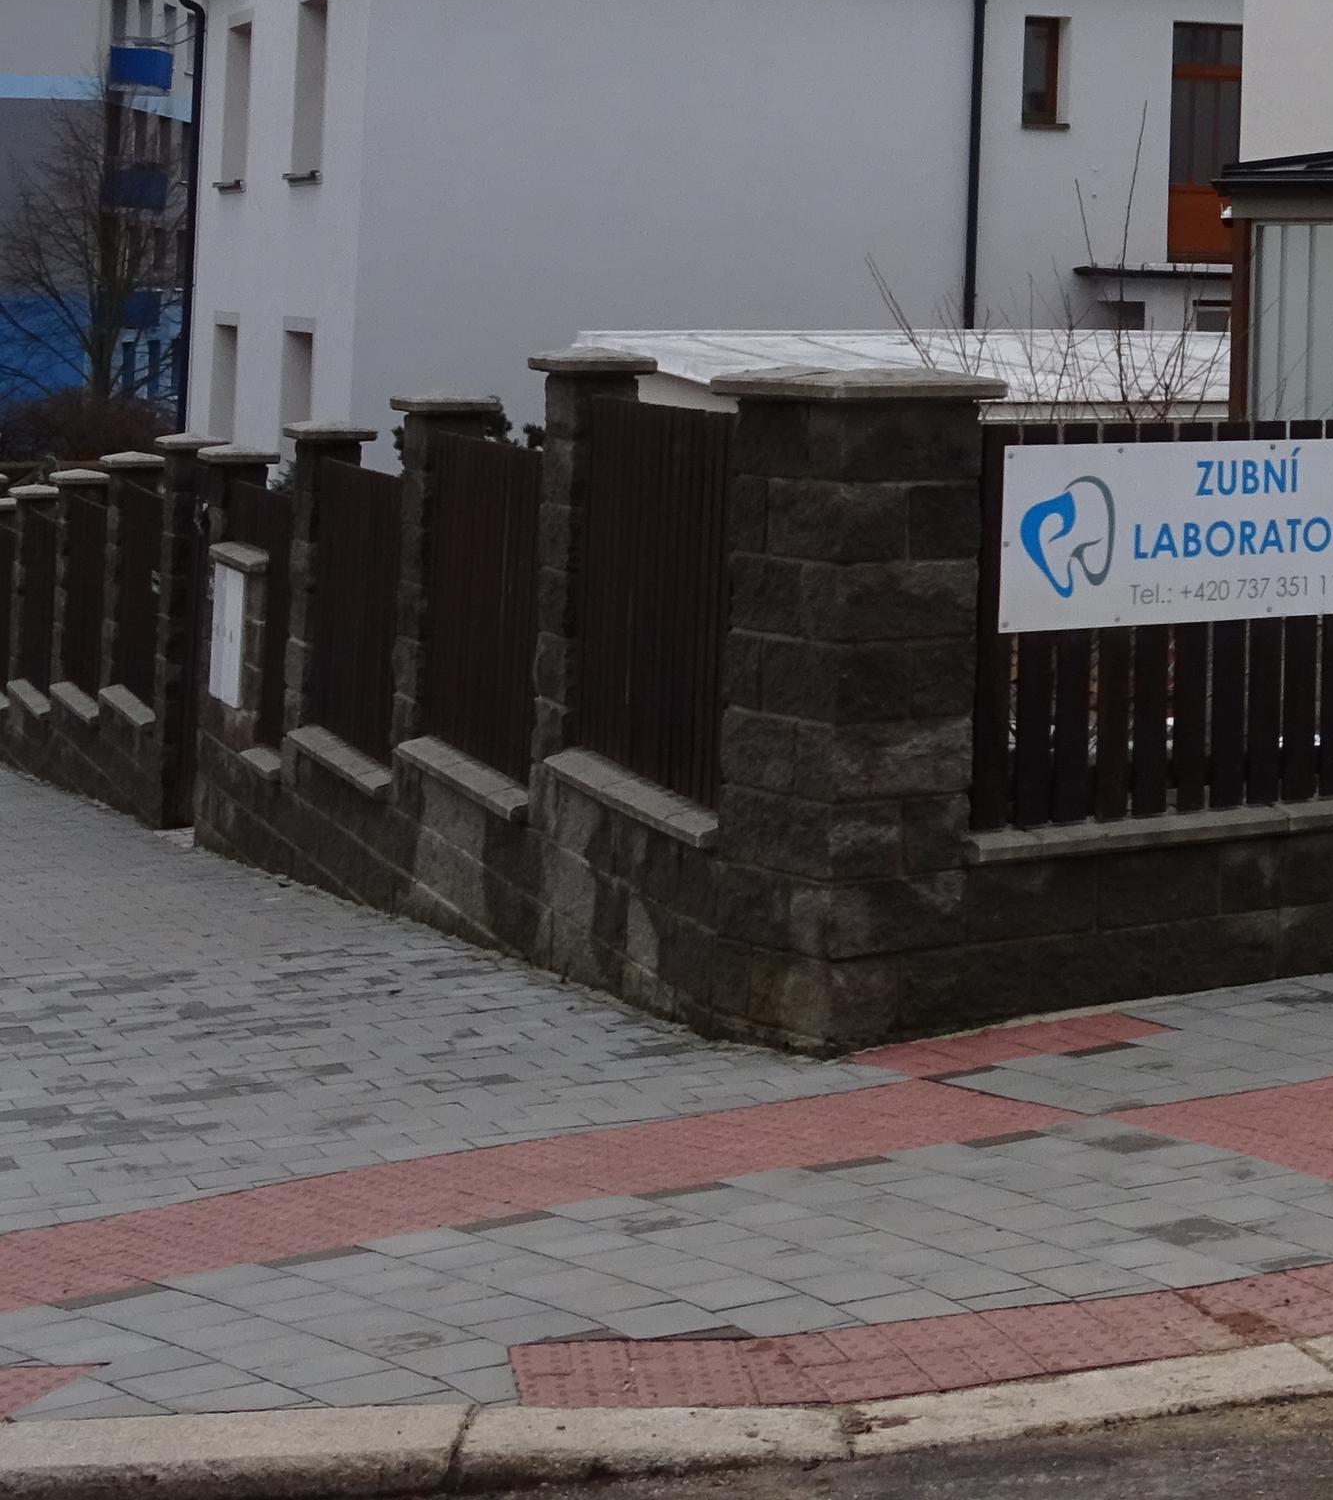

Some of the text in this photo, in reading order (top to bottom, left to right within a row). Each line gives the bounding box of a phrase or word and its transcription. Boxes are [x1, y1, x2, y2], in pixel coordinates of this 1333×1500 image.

[1196, 447, 1301, 496] ZUBNÍ
[1130, 583, 1172, 606] Tel.:
[1181, 580, 1230, 602] +420
[1236, 577, 1270, 600] 737
[1276, 575, 1308, 598] 351
